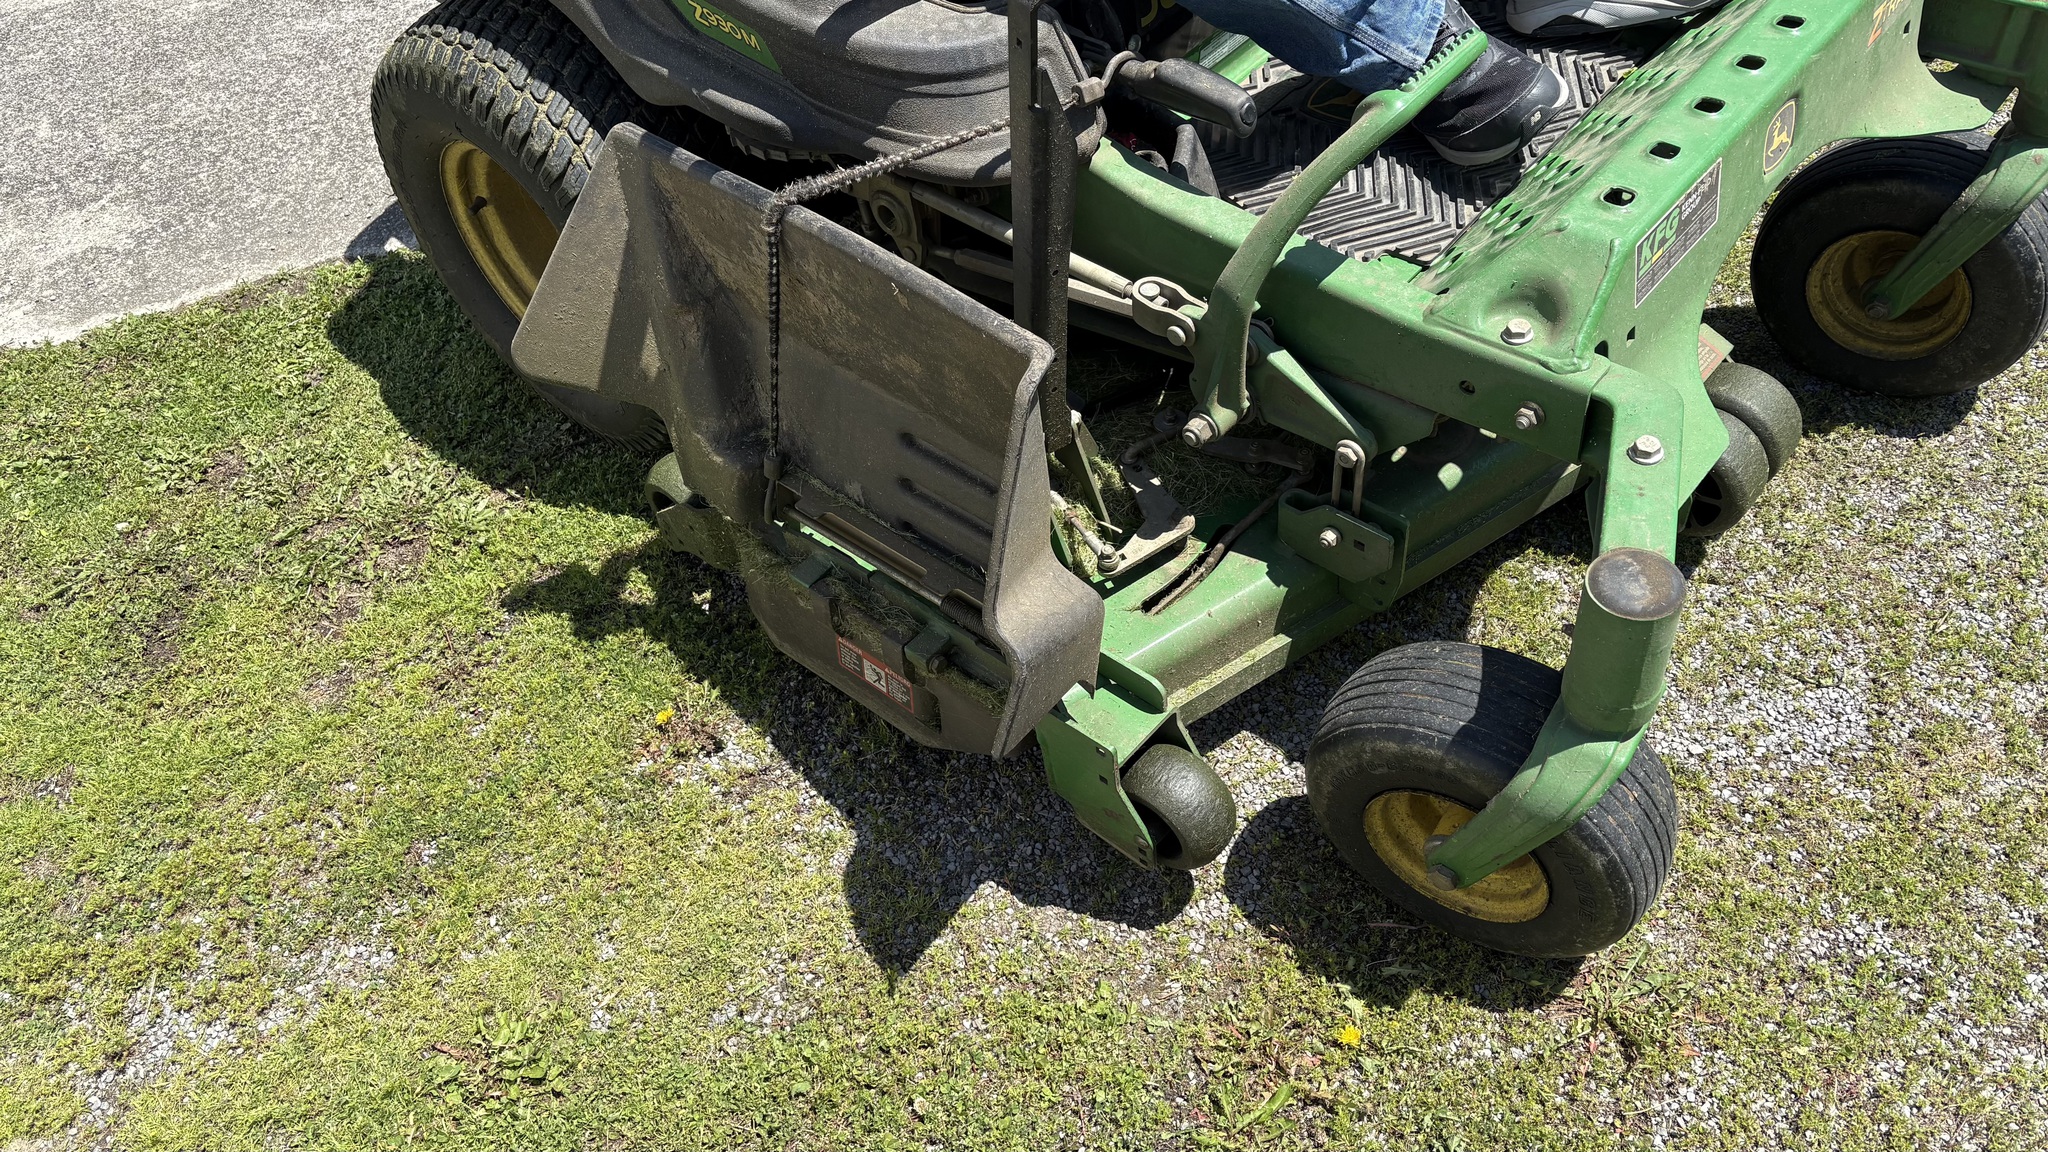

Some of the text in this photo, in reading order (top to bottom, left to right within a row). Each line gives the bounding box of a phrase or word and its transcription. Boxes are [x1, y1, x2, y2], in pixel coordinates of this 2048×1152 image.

[687, 0, 761, 51] Z930M
[1681, 195, 1702, 221] GROUP
[1640, 207, 1680, 268] KFG
